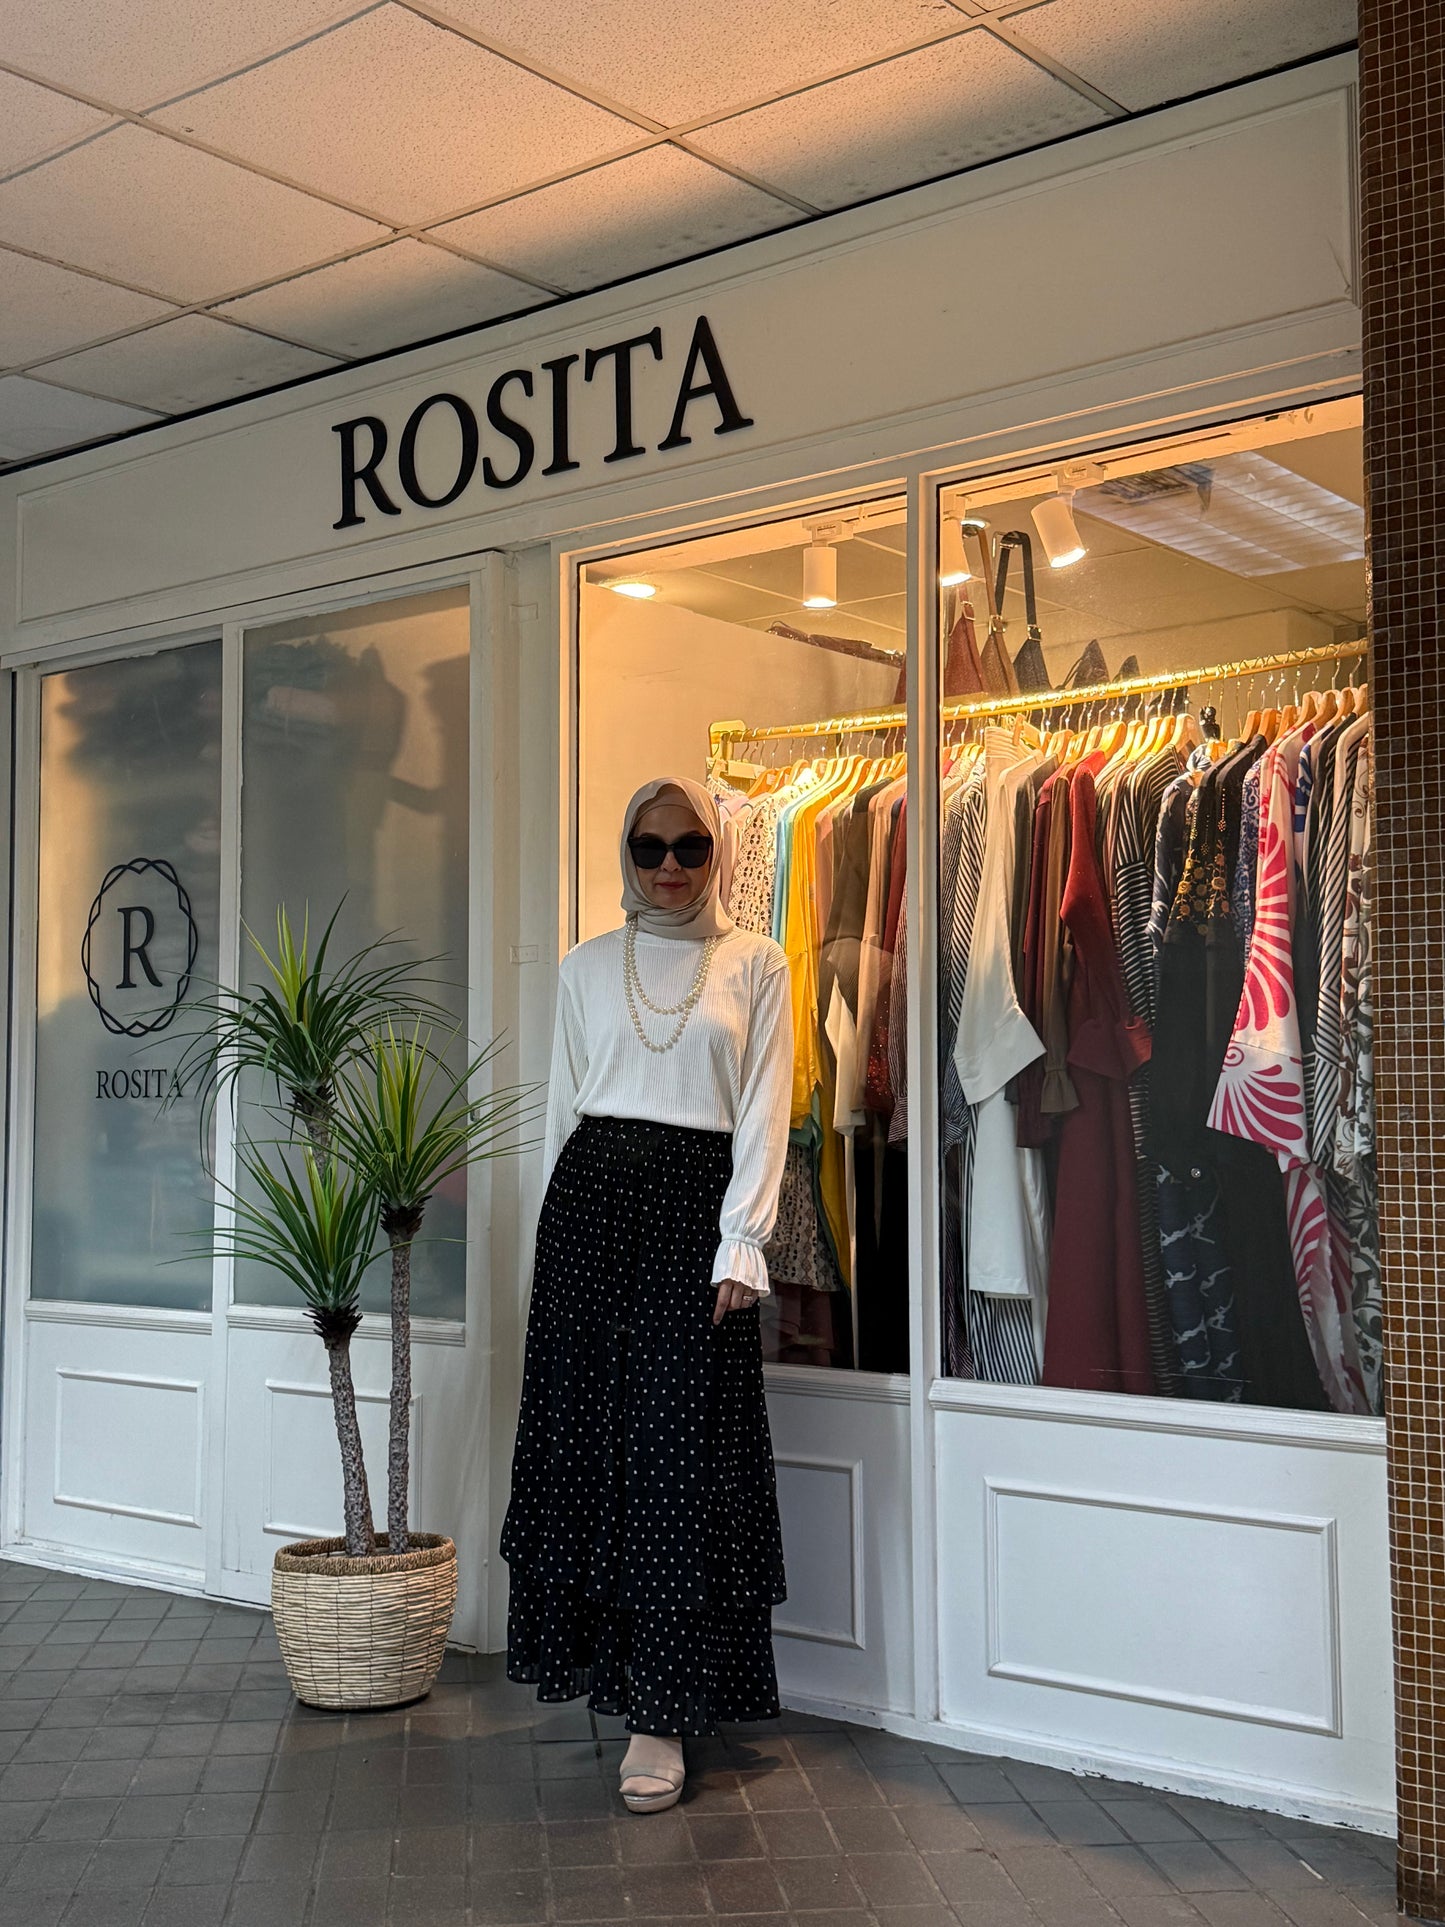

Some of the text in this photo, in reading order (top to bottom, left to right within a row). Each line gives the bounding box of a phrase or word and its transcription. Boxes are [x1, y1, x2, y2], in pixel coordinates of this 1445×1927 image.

[331, 315, 755, 530] ROSITA
[116, 906, 163, 989] R
[96, 1069, 183, 1099] ROSITA
